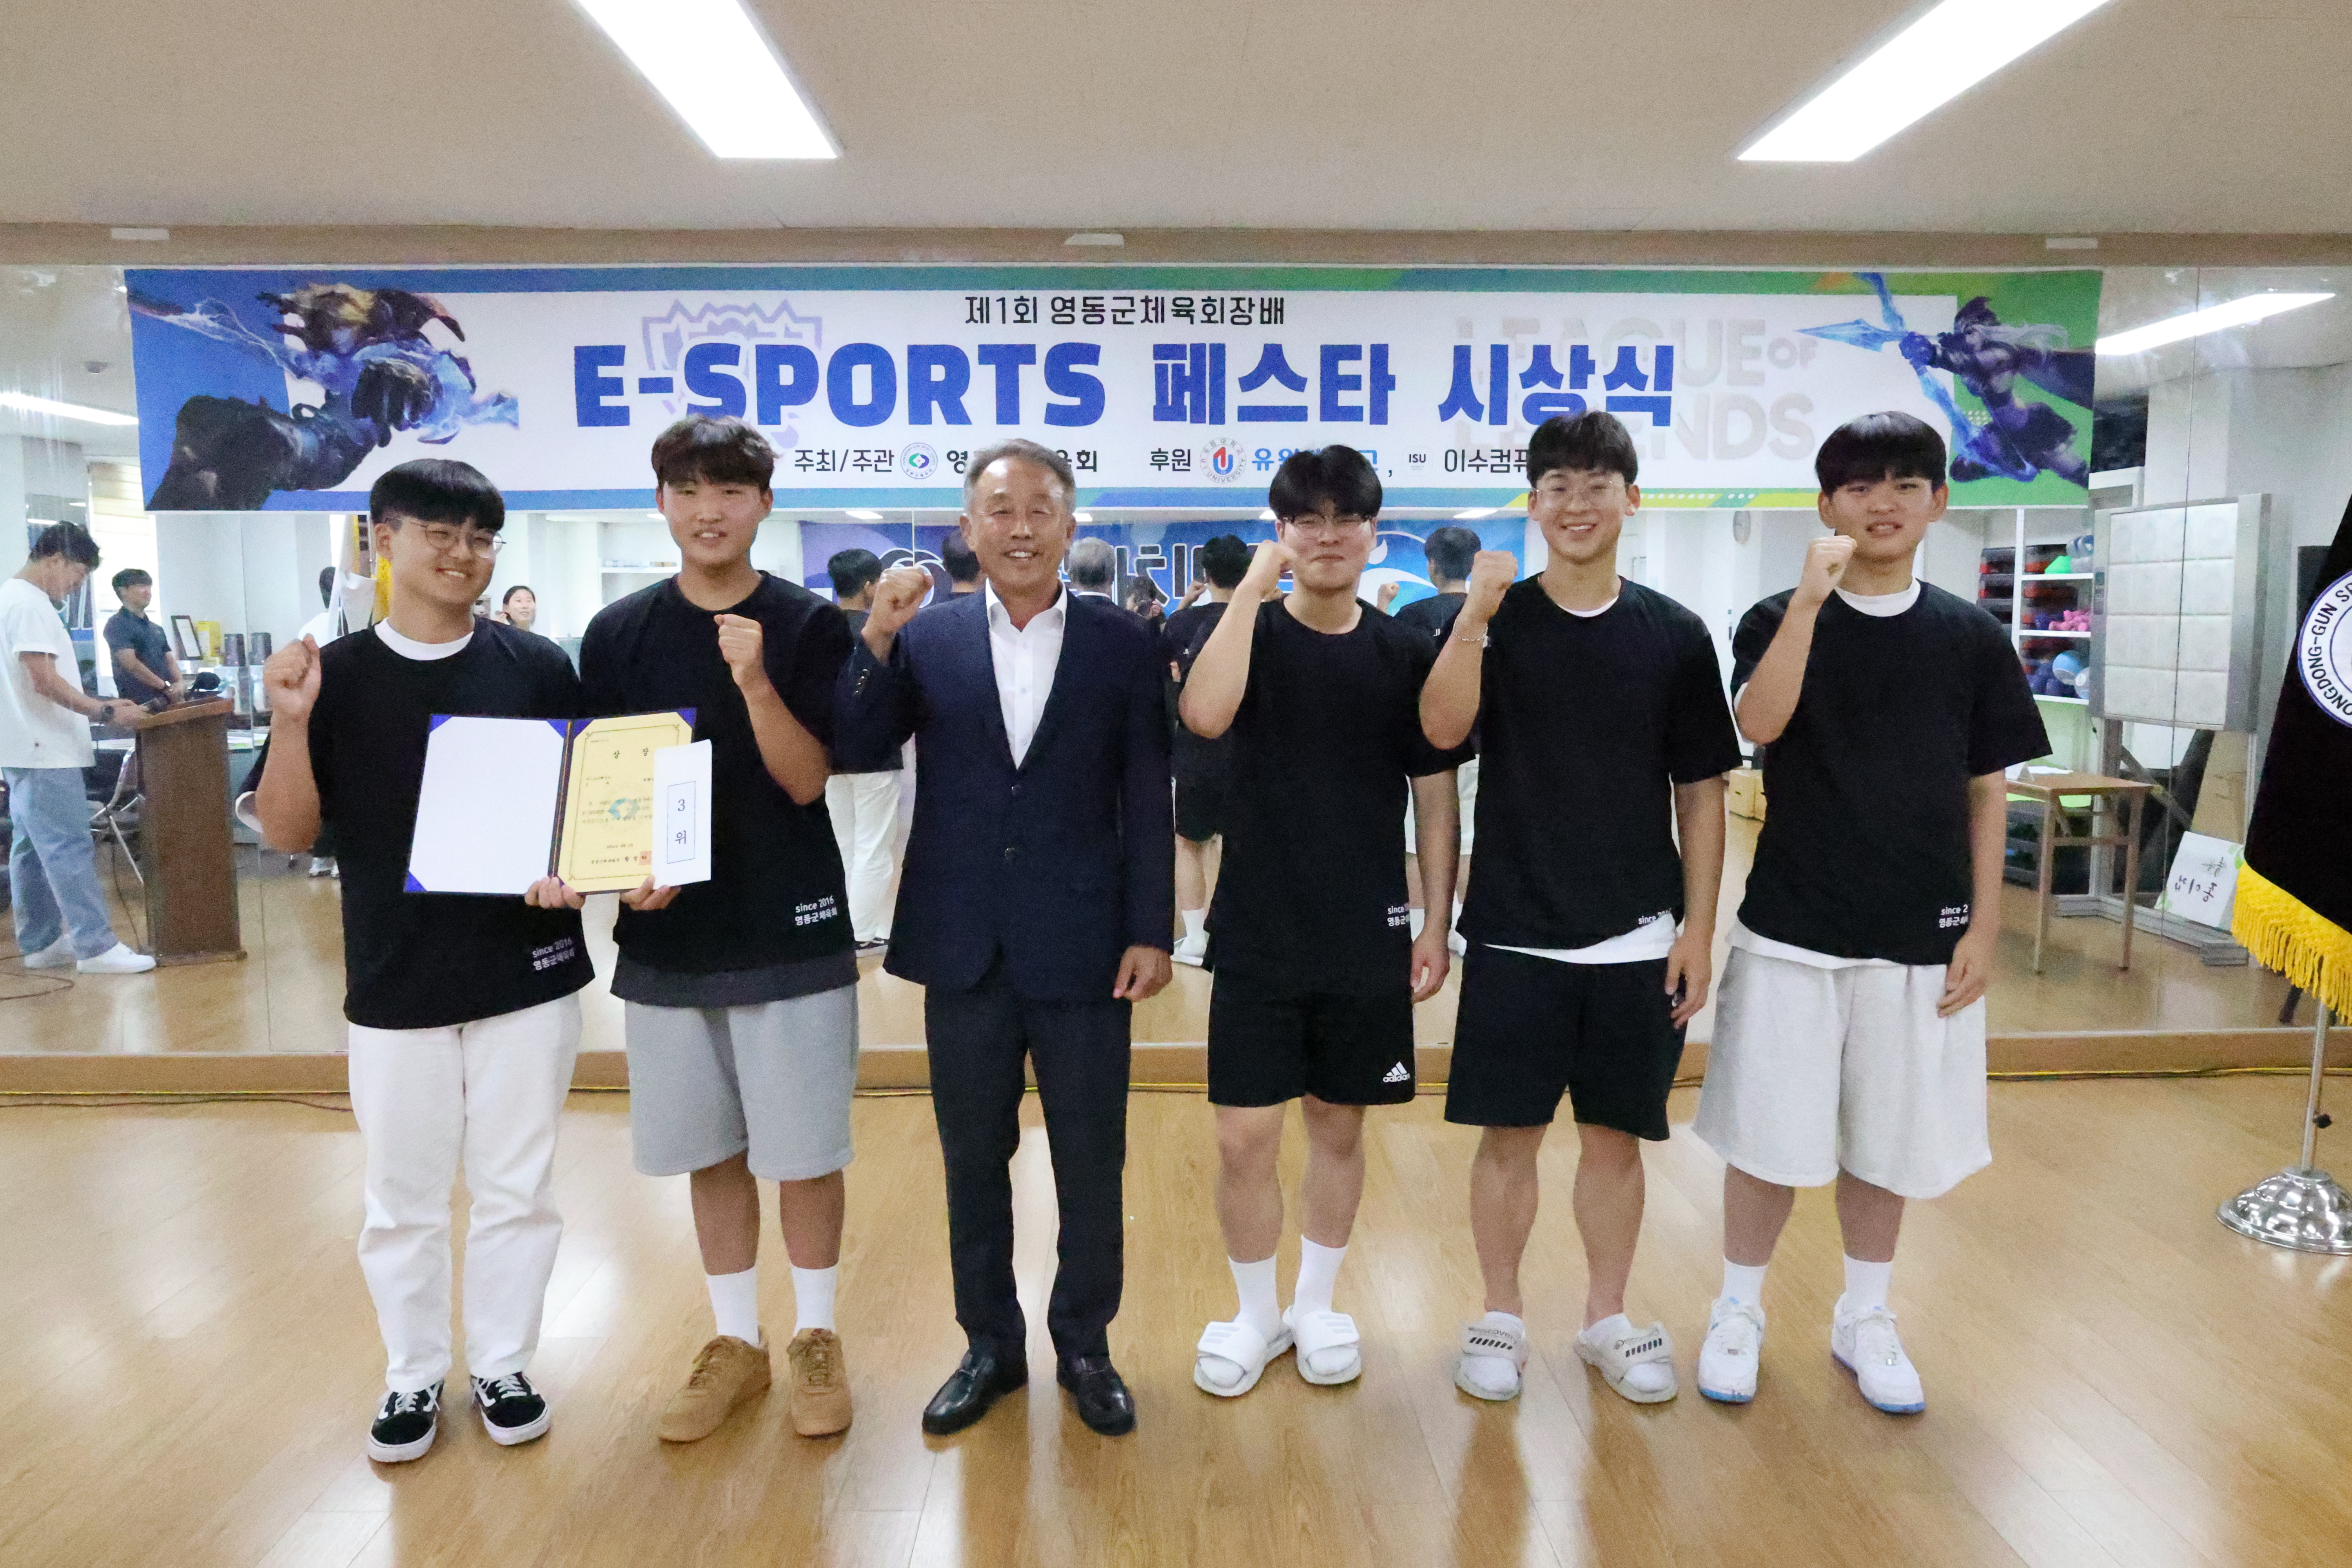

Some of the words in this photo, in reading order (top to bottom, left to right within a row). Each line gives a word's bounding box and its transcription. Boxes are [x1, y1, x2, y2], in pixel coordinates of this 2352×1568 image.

[965, 296, 1038, 325] 제1회
[1051, 296, 1286, 325] 영동군체육회장배
[574, 342, 1105, 427] E-SPORTS
[1153, 342, 1396, 426] 페스타
[1438, 343, 1674, 427] 시상식
[794, 449, 894, 472] 주최/주관
[1150, 448, 1191, 472] 후원
[1409, 454, 1426, 463] ISU
[1445, 449, 1529, 473] 이수컴퓨
[1207, 459, 1245, 482] UNIVERSITY
[678, 799, 685, 811] 3
[675, 830, 686, 844] 위
[795, 903, 817, 913] since
[818, 895, 834, 908] 2016
[1388, 906, 1404, 914] since
[1941, 906, 1961, 915] since
[795, 907, 838, 926] 영동군체육회
[1387, 915, 1408, 927] 영동군
[1638, 915, 1657, 925] since
[532, 946, 554, 958] since
[554, 936, 572, 950] 2016
[1383, 1073, 1410, 1083] adidas
